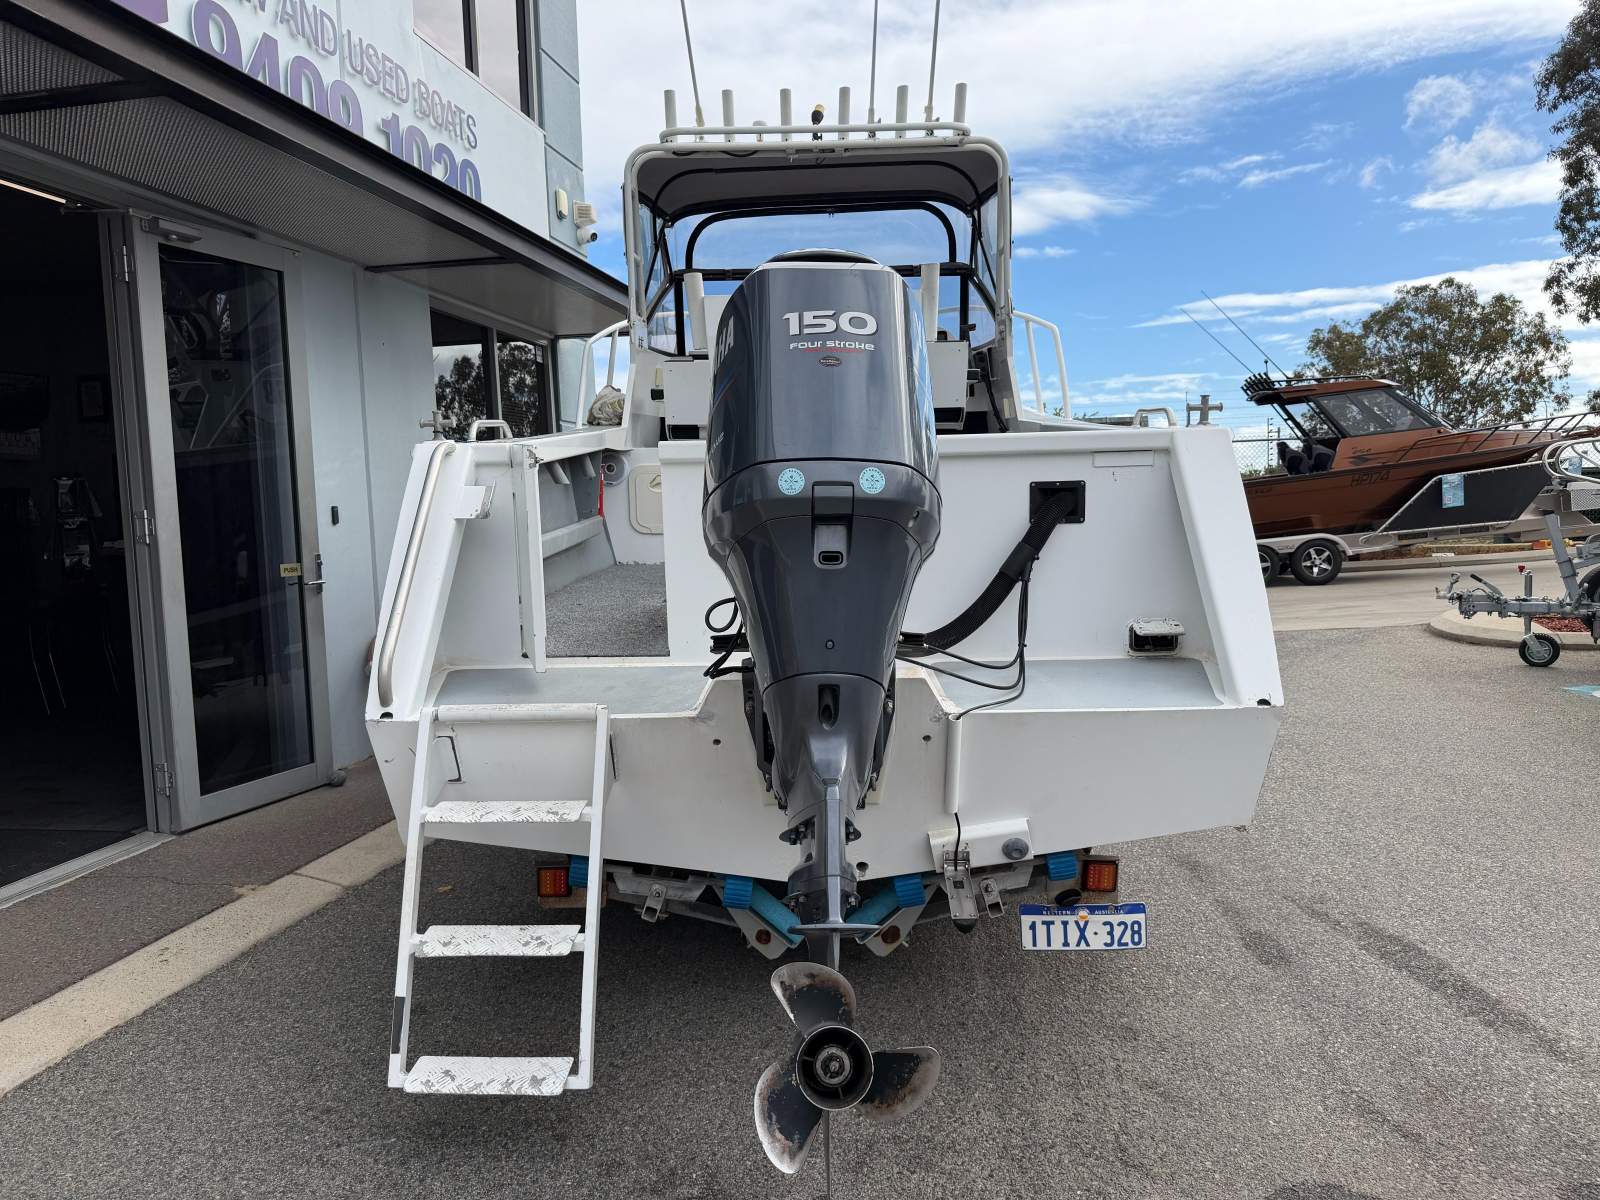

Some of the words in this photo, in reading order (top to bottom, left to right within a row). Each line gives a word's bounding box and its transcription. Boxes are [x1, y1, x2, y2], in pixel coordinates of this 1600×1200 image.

[278, 0, 339, 57] AND
[346, 29, 410, 104] USED
[413, 77, 479, 150] BOATS
[782, 310, 878, 336] 150
